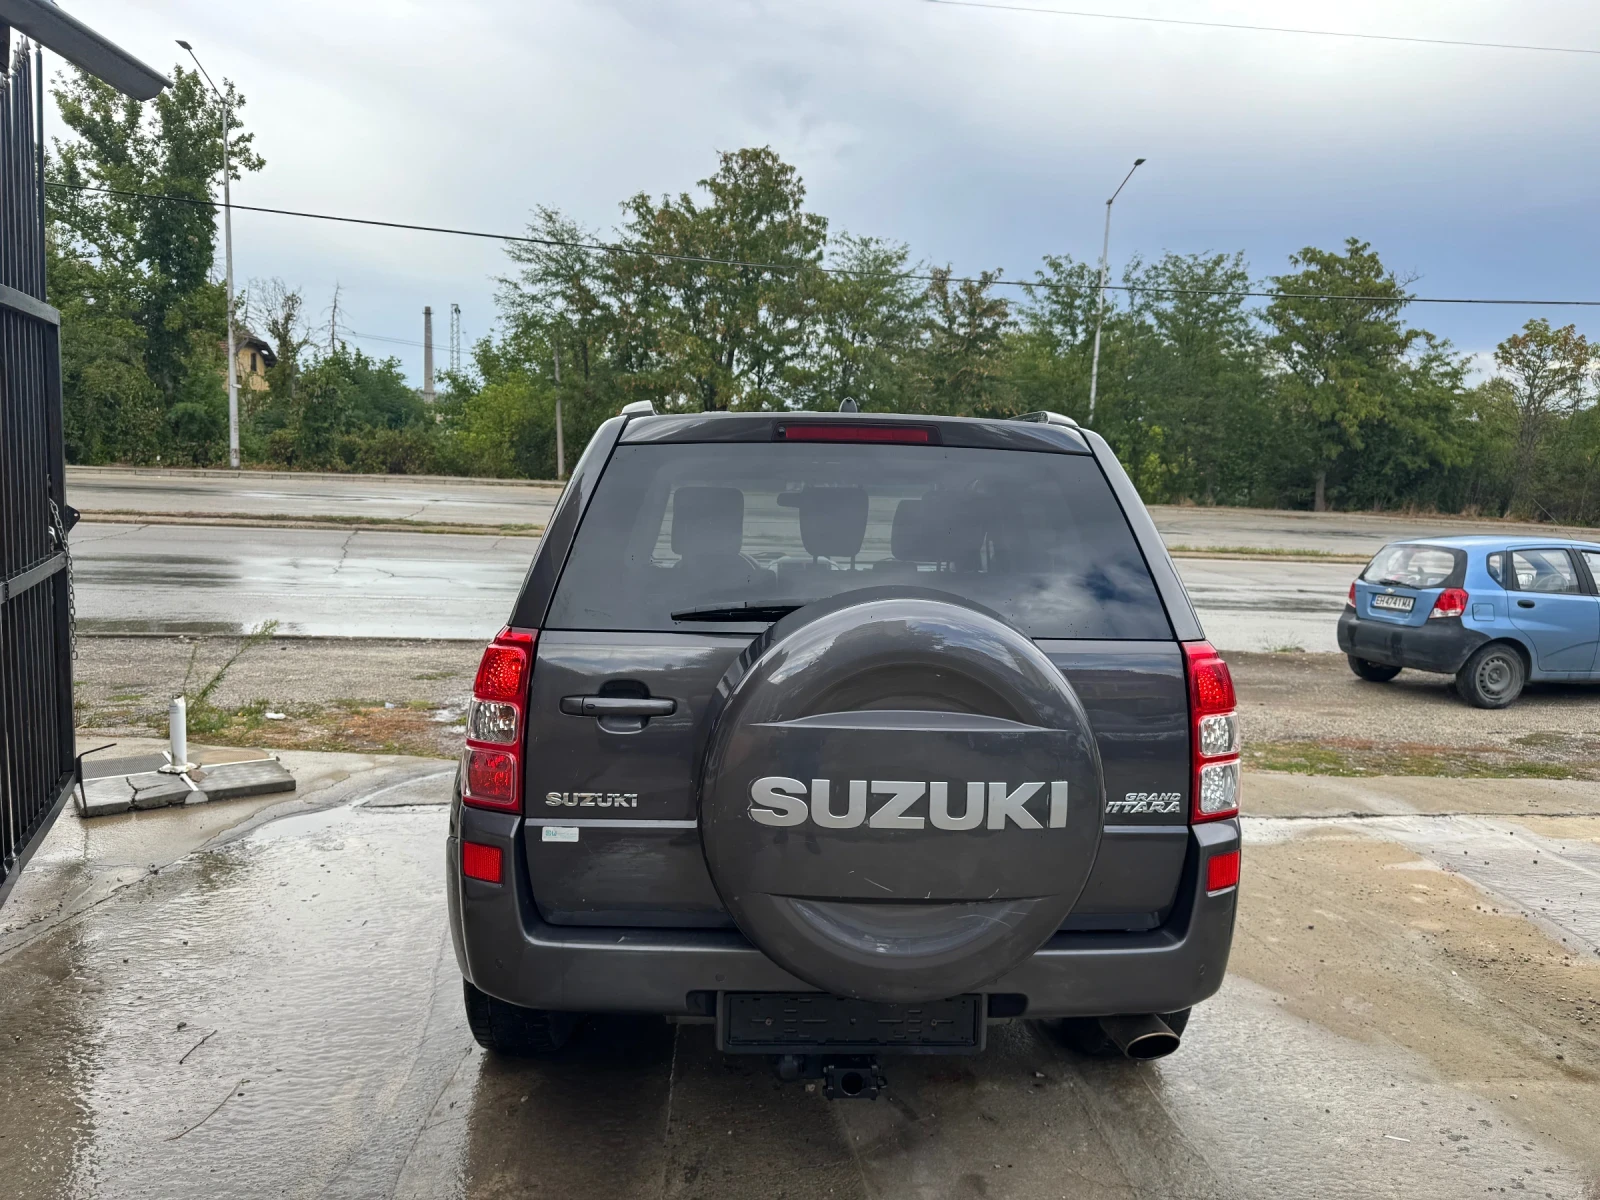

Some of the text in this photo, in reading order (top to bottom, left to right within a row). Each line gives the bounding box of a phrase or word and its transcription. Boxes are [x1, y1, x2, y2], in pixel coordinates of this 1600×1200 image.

[545, 792, 638, 807] SUZUKI
[750, 776, 1068, 830] SUZUKI
[1125, 792, 1181, 802] GRAND
